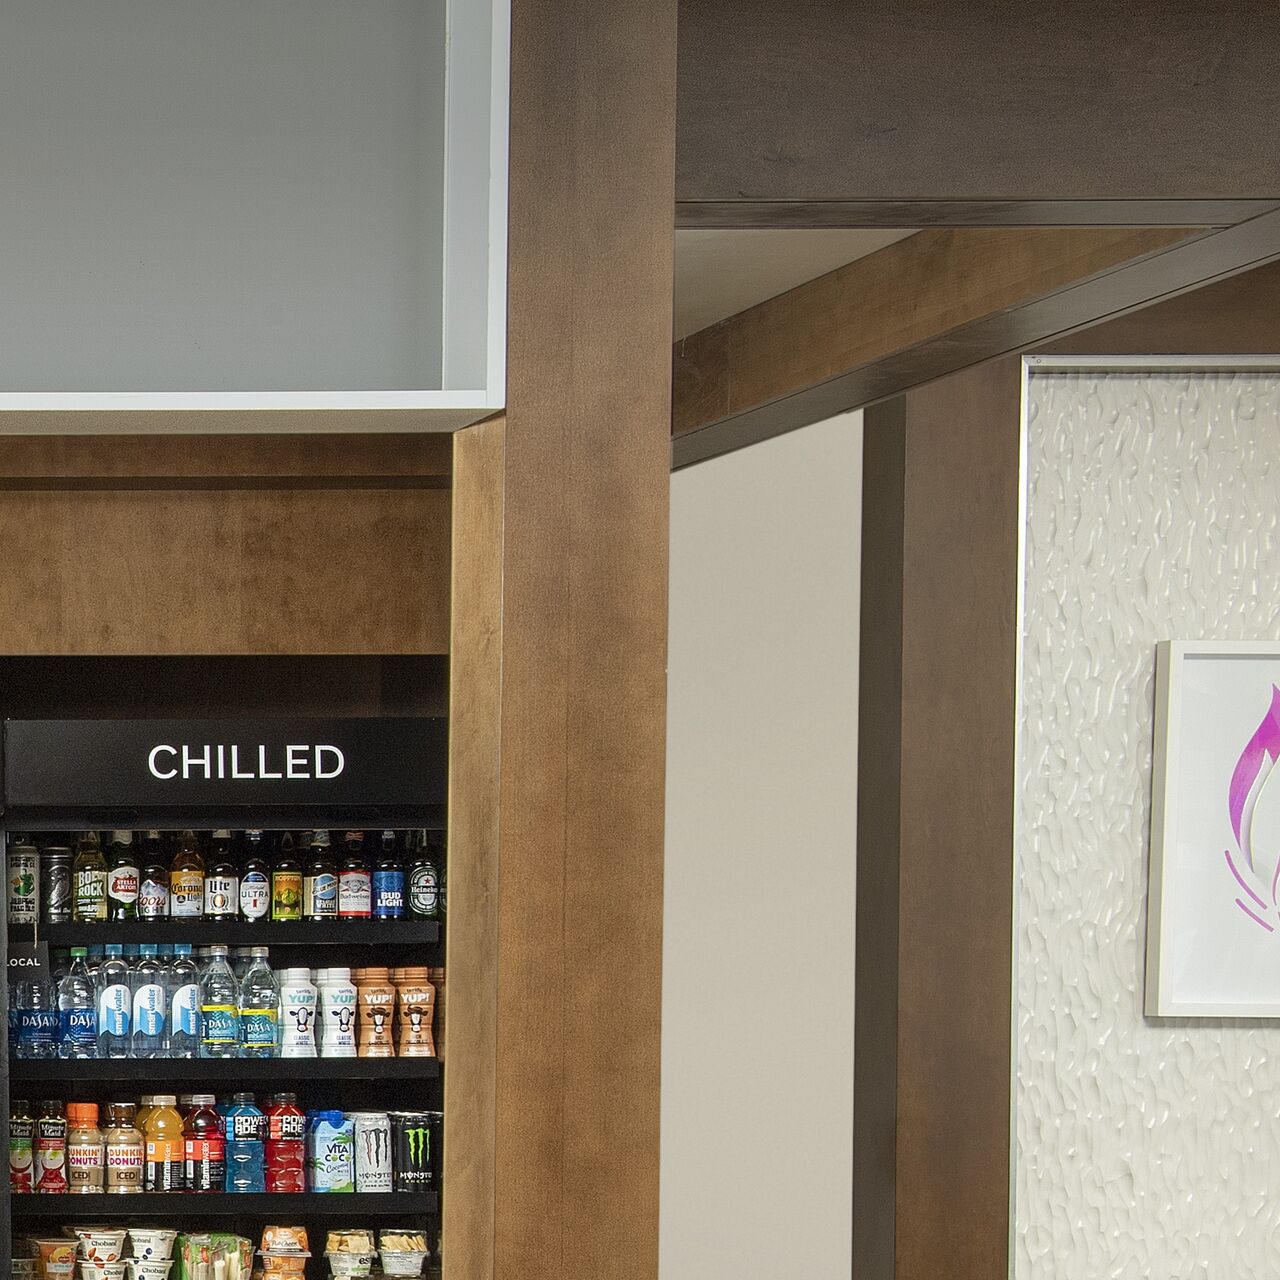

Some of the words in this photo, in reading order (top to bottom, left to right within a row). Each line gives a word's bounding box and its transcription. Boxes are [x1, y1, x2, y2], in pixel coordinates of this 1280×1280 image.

[147, 744, 346, 781] CHILLED
[79, 881, 104, 897] ROCK
[209, 880, 230, 894] Lite
[241, 890, 269, 899] ULTRA
[380, 891, 401, 900] BUD
[377, 899, 403, 908] LIGHT
[364, 994, 392, 1004] YUP!
[401, 993, 429, 1003] YUP!
[326, 1144, 349, 1154] VITA
[117, 1171, 136, 1181] ICED
[141, 1267, 167, 1275] Chobani
